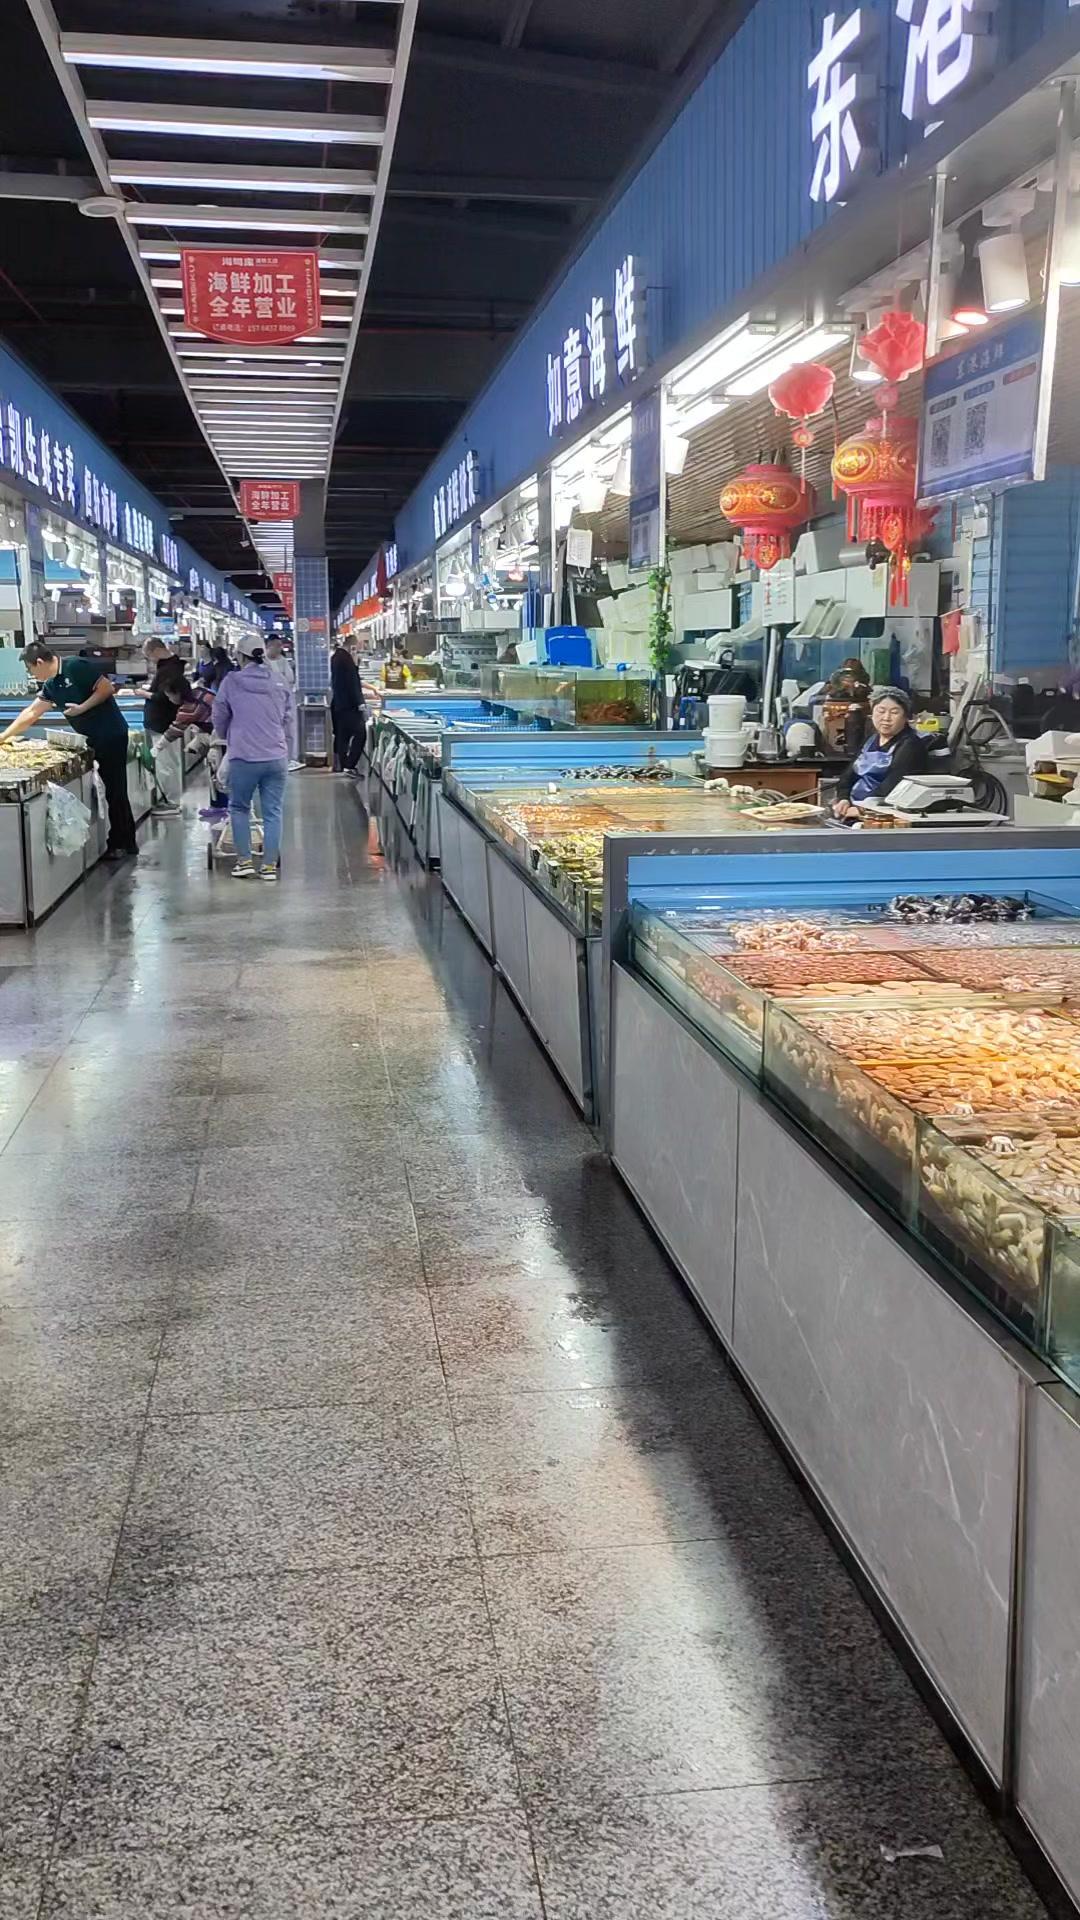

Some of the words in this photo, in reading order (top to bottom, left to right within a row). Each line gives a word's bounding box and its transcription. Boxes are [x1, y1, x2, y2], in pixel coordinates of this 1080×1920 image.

[207, 271, 297, 294] 海鲜加工
[208, 295, 297, 319] 全年营业
[546, 254, 638, 438] 如意海鲜
[0, 401, 76, 508] 凯生蚝专卖
